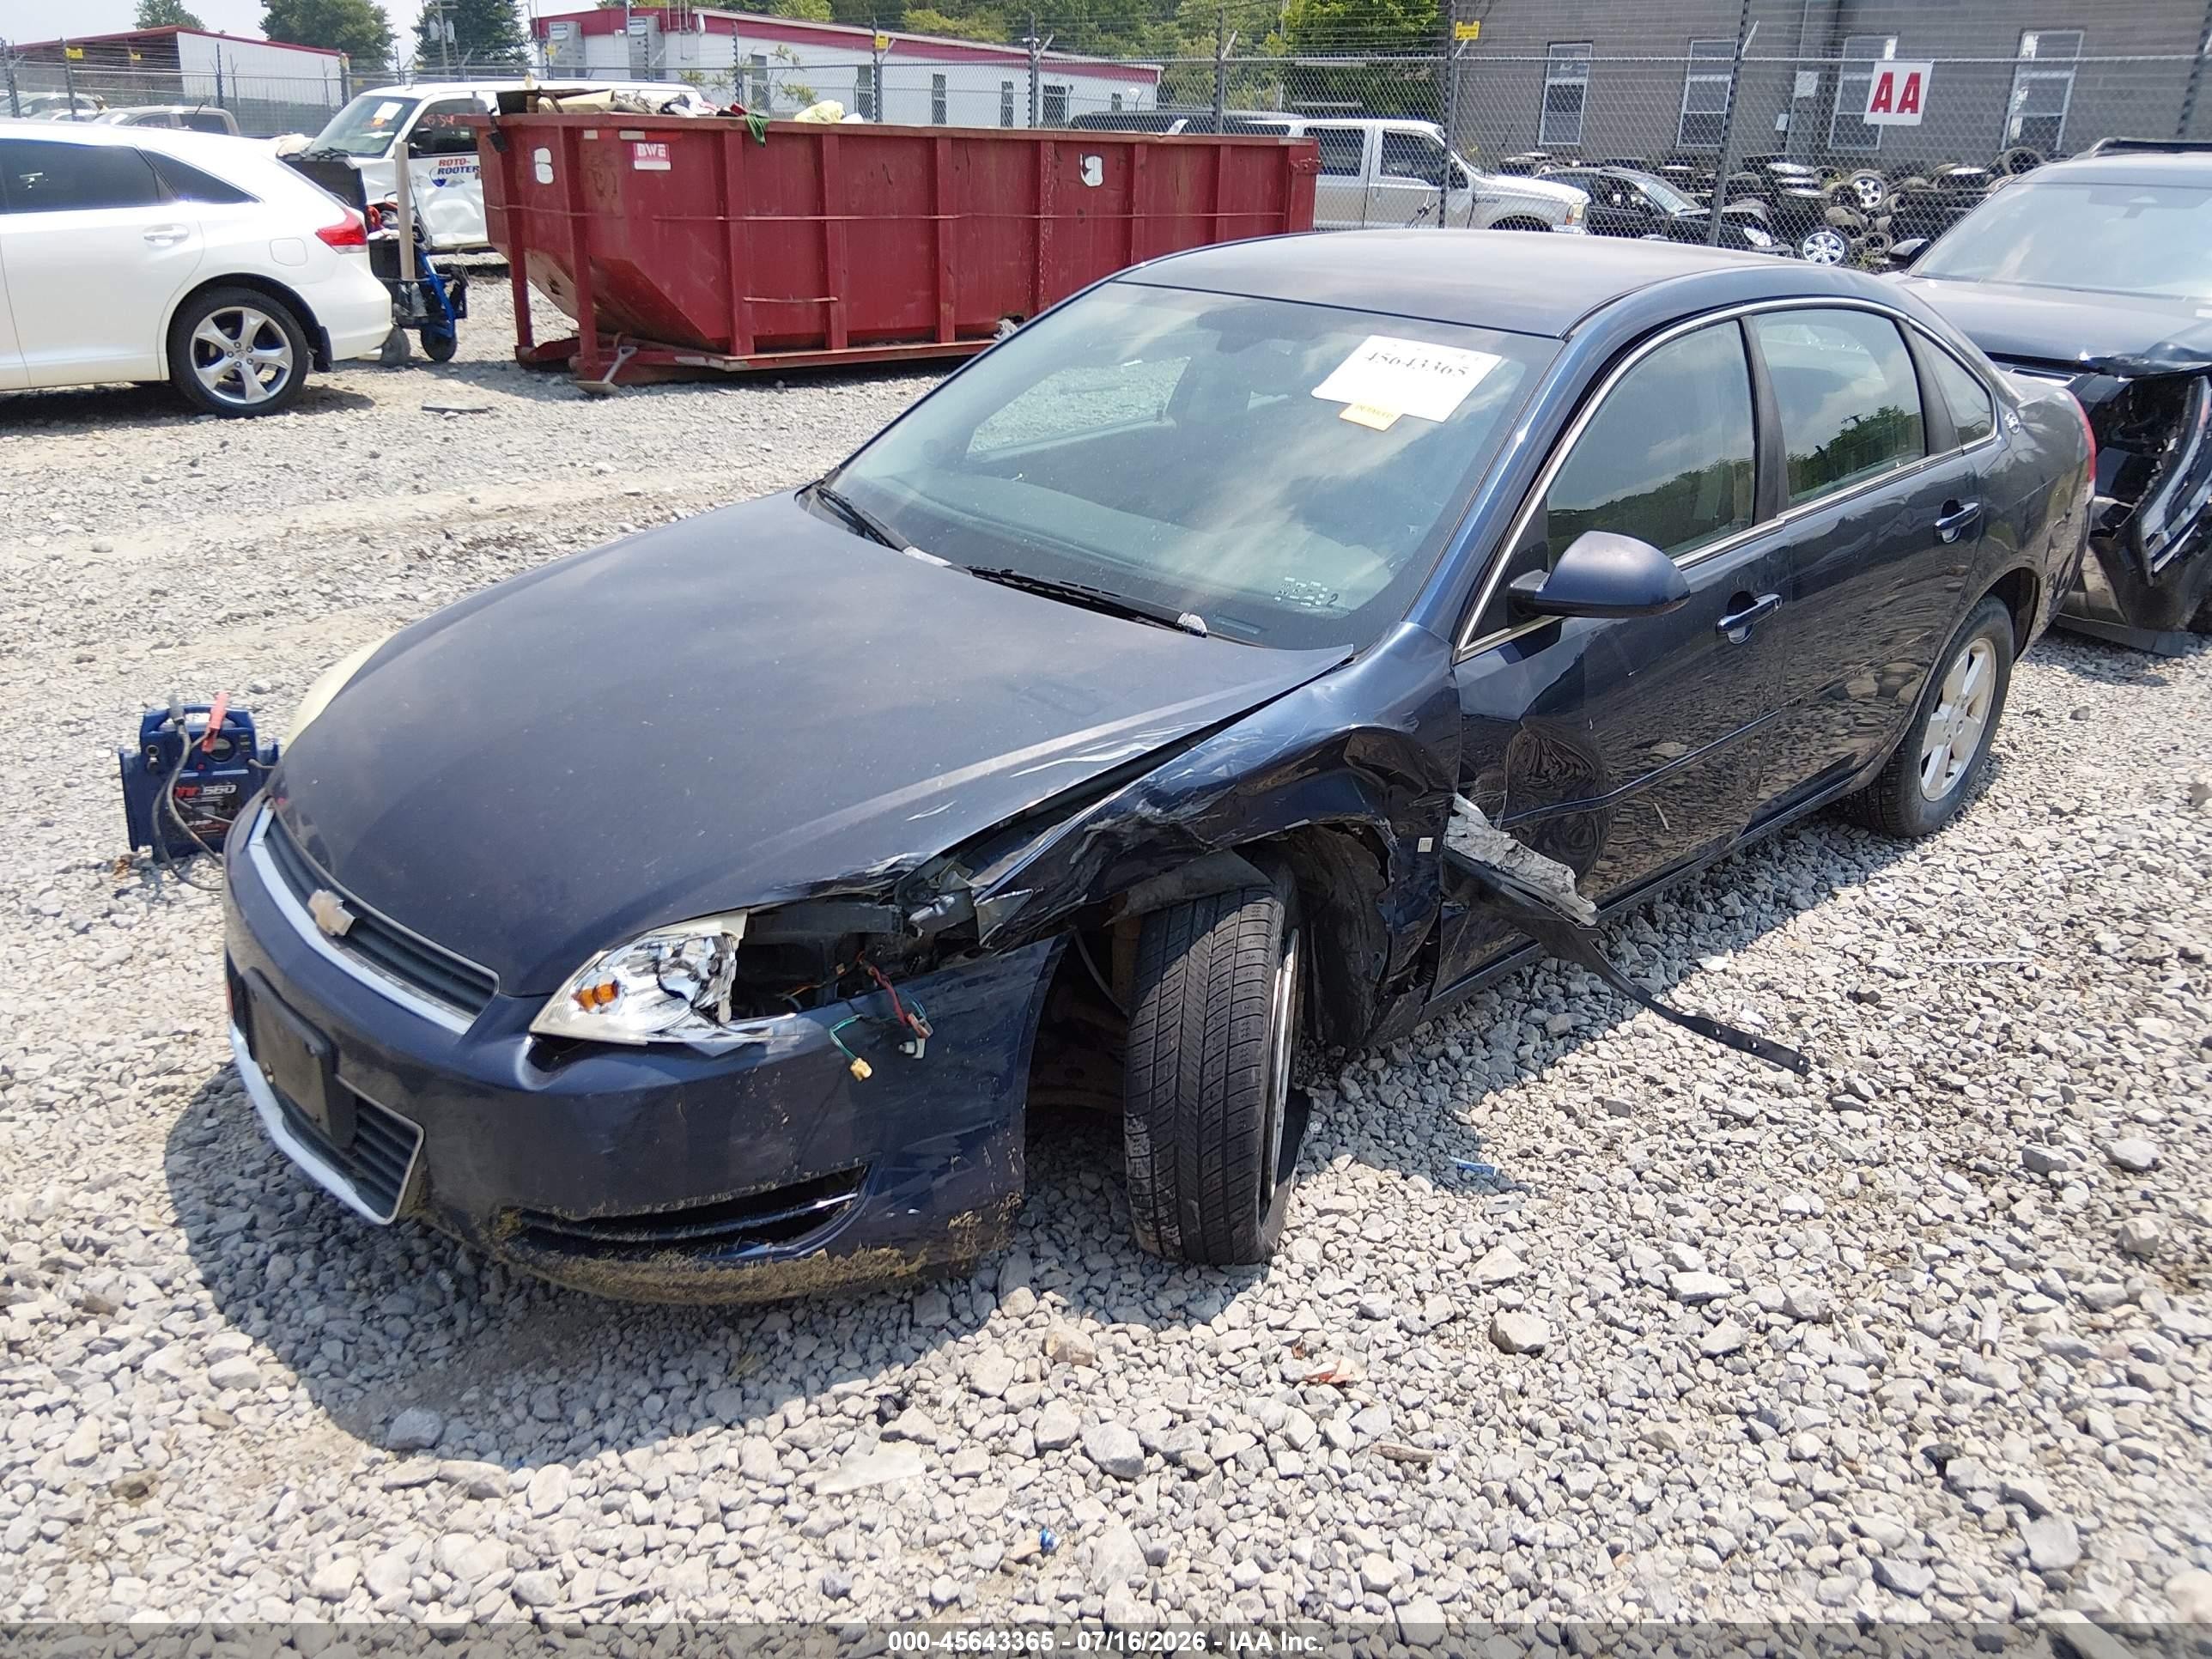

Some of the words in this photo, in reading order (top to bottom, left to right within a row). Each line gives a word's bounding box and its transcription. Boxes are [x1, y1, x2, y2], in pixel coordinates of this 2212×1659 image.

[1869, 71, 1922, 114] AA
[439, 157, 471, 167] ROTO-
[437, 165, 481, 175] ROOTER
